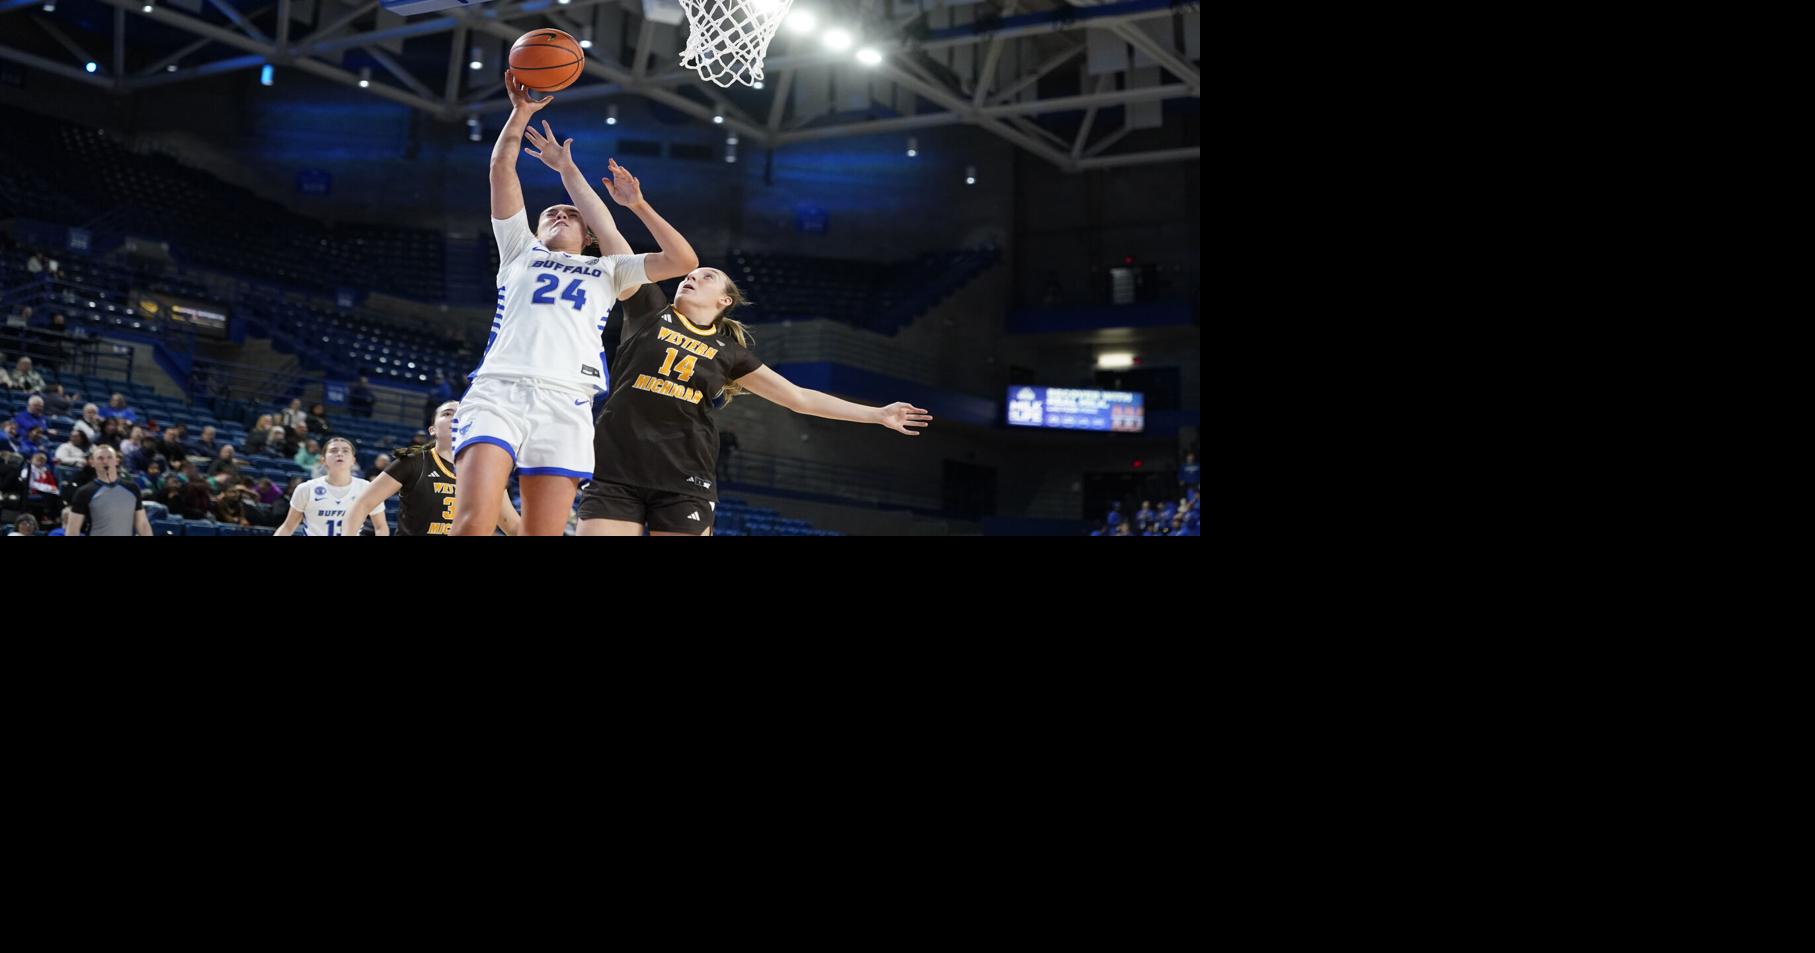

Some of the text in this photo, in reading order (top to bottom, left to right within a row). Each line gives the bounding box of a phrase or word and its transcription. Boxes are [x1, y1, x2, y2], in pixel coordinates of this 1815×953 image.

[532, 260, 602, 278] BUFFALO
[531, 273, 586, 311] 24
[657, 326, 718, 360] WESTERN
[657, 347, 698, 382] 14
[631, 373, 704, 405] MICHIGAN
